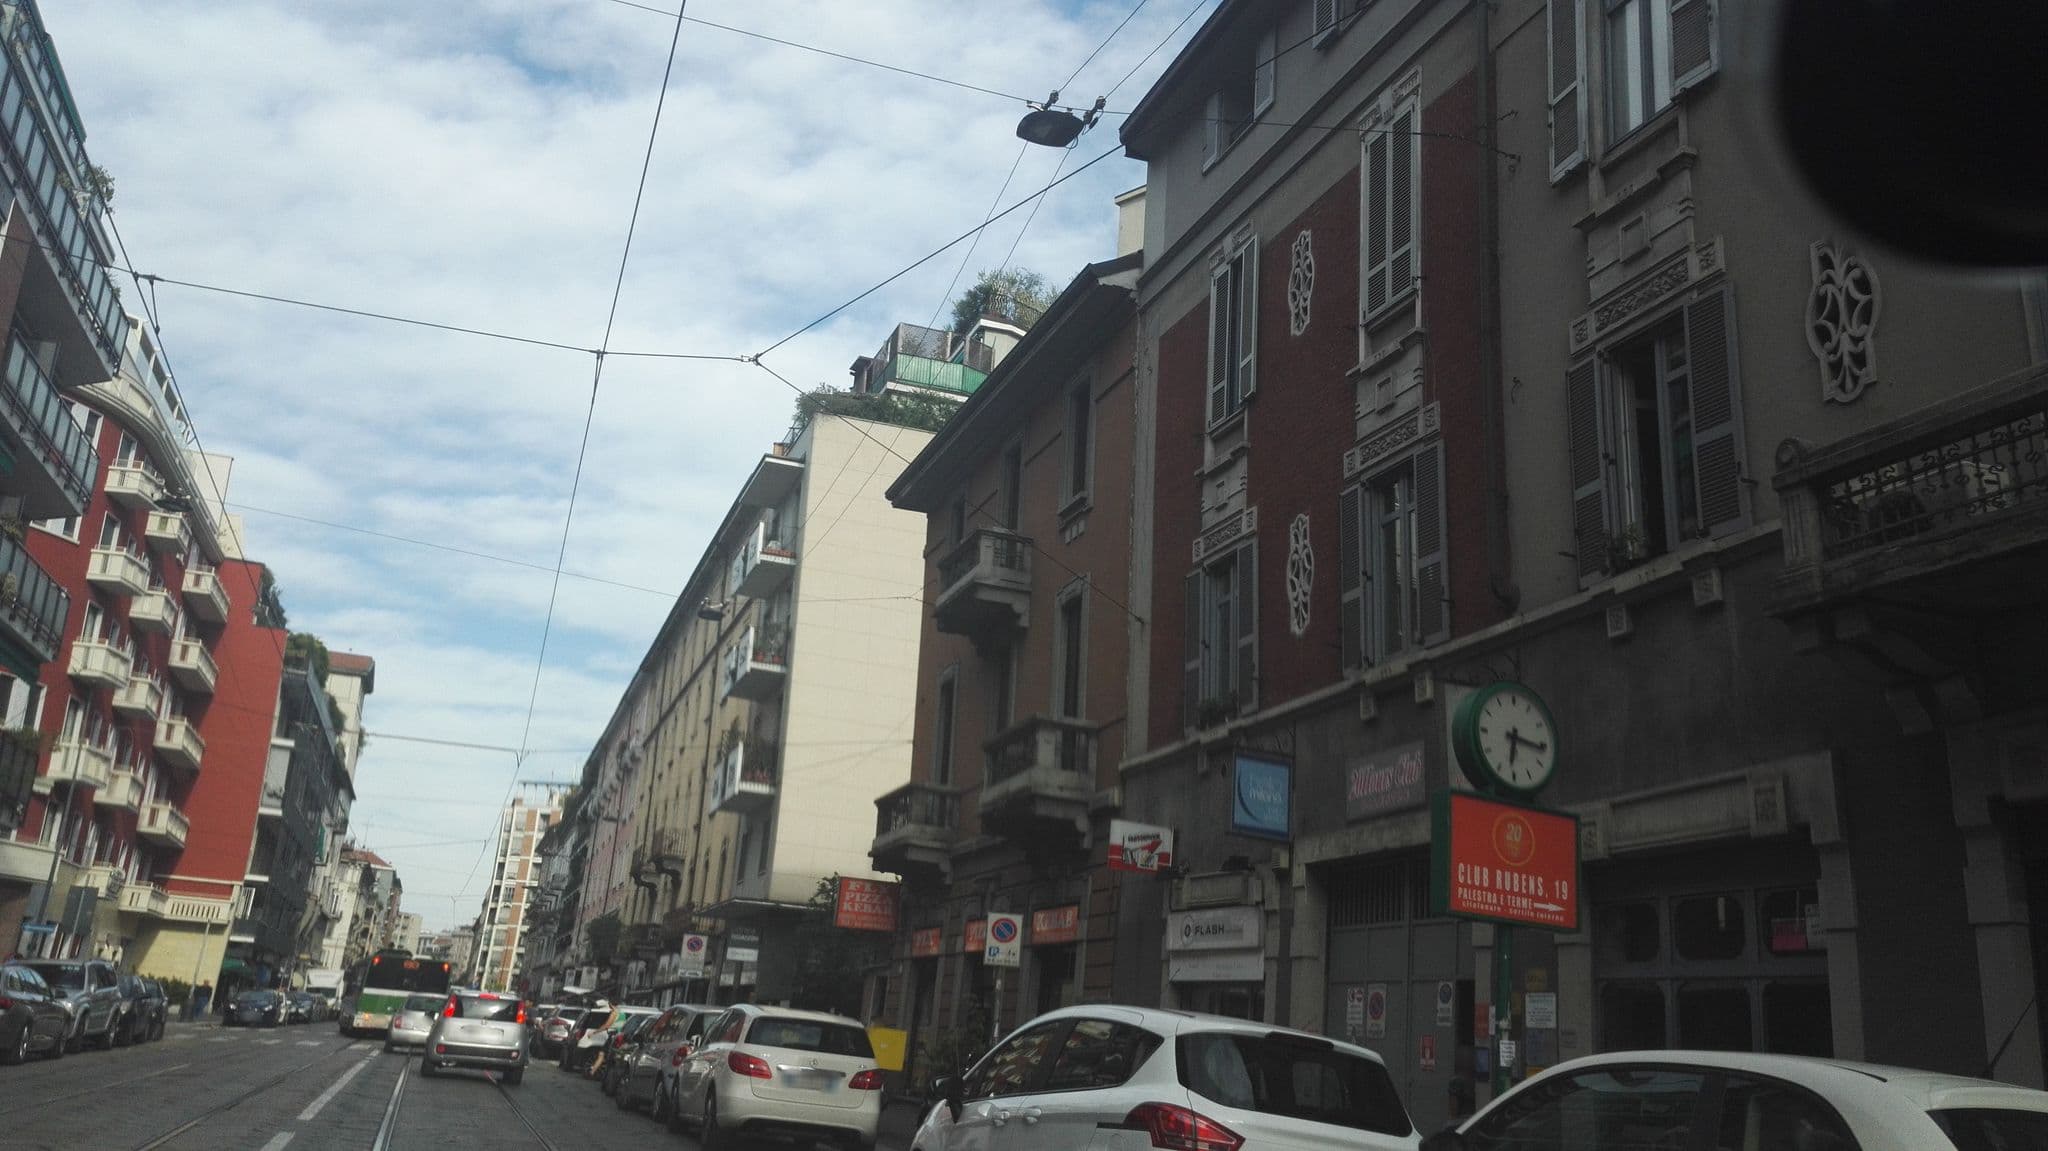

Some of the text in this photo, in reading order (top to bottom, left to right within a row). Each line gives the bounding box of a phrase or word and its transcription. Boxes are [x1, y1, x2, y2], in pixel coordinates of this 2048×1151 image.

[1457, 862, 1489, 888] CLUB
[1554, 880, 1568, 901] 19
[845, 892, 892, 904] PIZZA
[1457, 887, 1498, 904] PALESTRA
[1507, 896, 1533, 908] TERME
[1194, 924, 1225, 936] FLASH
